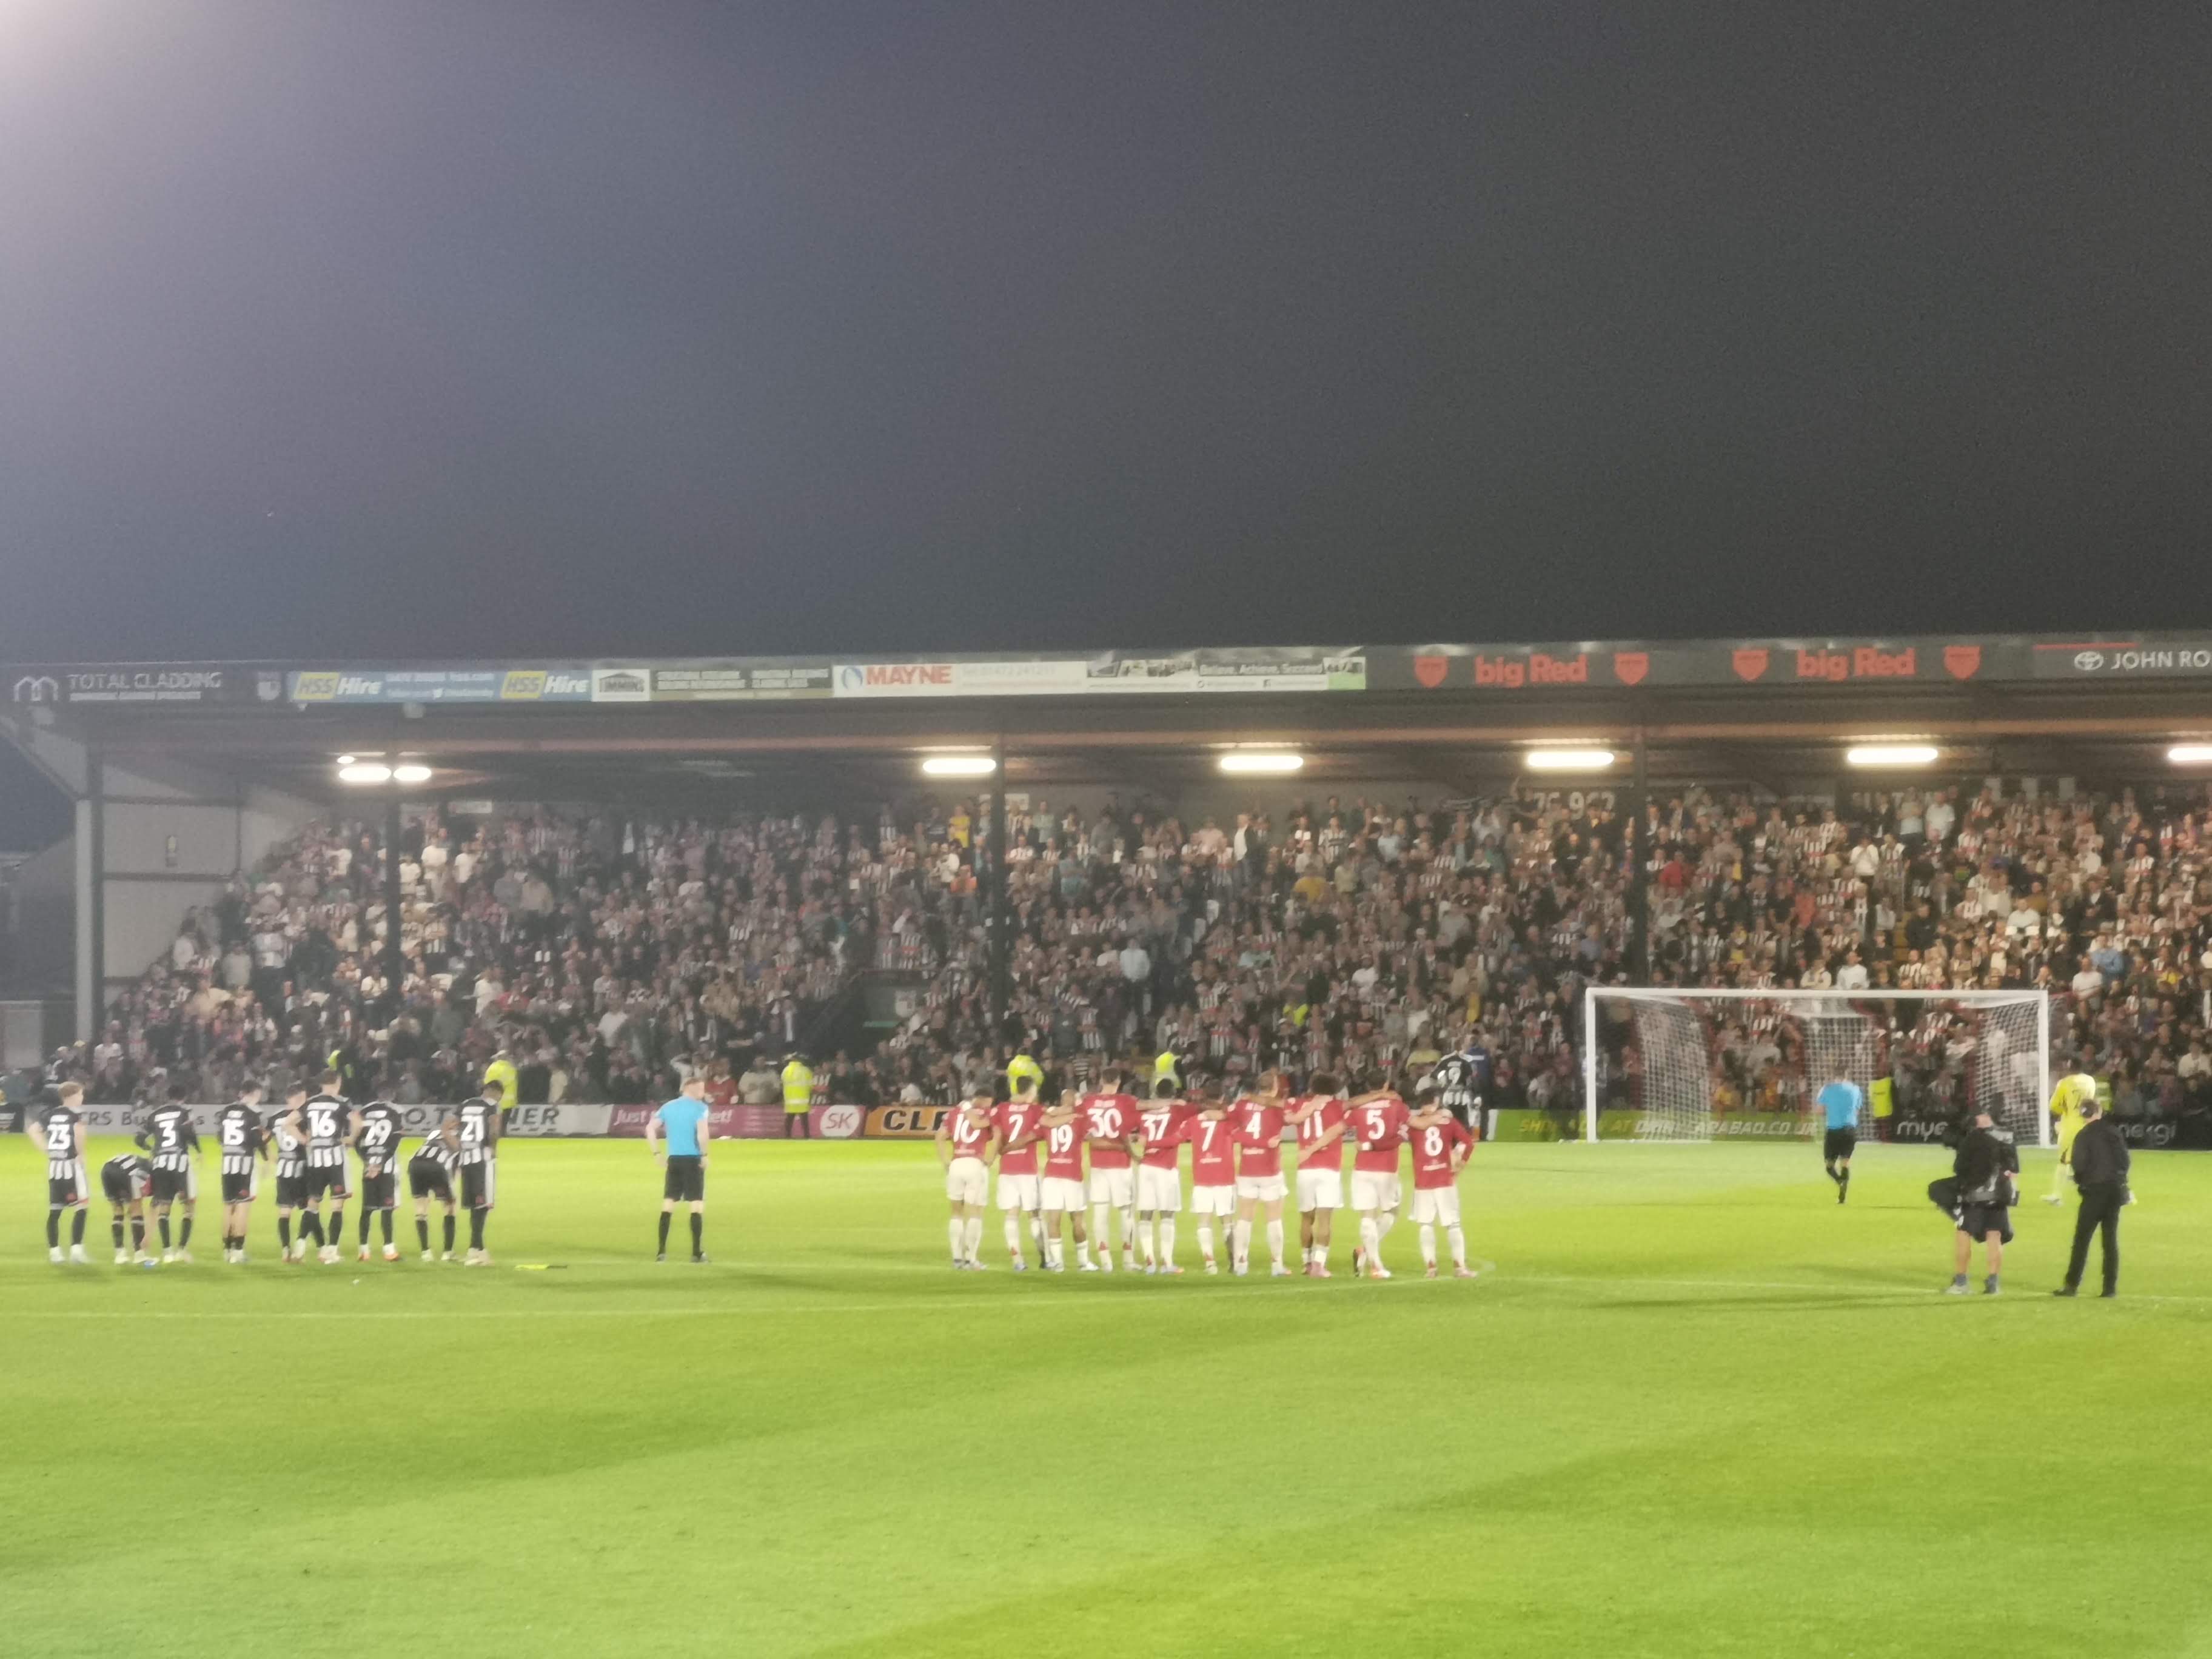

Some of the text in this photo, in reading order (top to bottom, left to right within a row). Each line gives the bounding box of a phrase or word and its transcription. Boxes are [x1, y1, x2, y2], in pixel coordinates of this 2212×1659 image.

[1475, 652, 1587, 688] big Red
[1796, 647, 1916, 682] big Red
[2110, 650, 2211, 669] JOHN RO
[67, 671, 223, 689] TOTAL CLADDING
[337, 677, 381, 695] Hire
[544, 675, 589, 694] Hire
[866, 666, 952, 685] MAYNE
[47, 1124, 70, 1151] 23
[158, 1120, 176, 1147] 3
[222, 1119, 244, 1145] 15
[307, 1110, 337, 1138] 16
[362, 1119, 392, 1146] 29
[461, 1114, 484, 1142] 21
[1087, 1108, 1122, 1139] 30
[1141, 1113, 1171, 1142] 37
[1201, 1121, 1216, 1152] 7
[1245, 1111, 1261, 1140] 4
[1303, 1111, 1323, 1139] 11
[1366, 1110, 1386, 1140] 5
[1050, 1124, 1073, 1153] 19
[1425, 1126, 1444, 1156] 8
